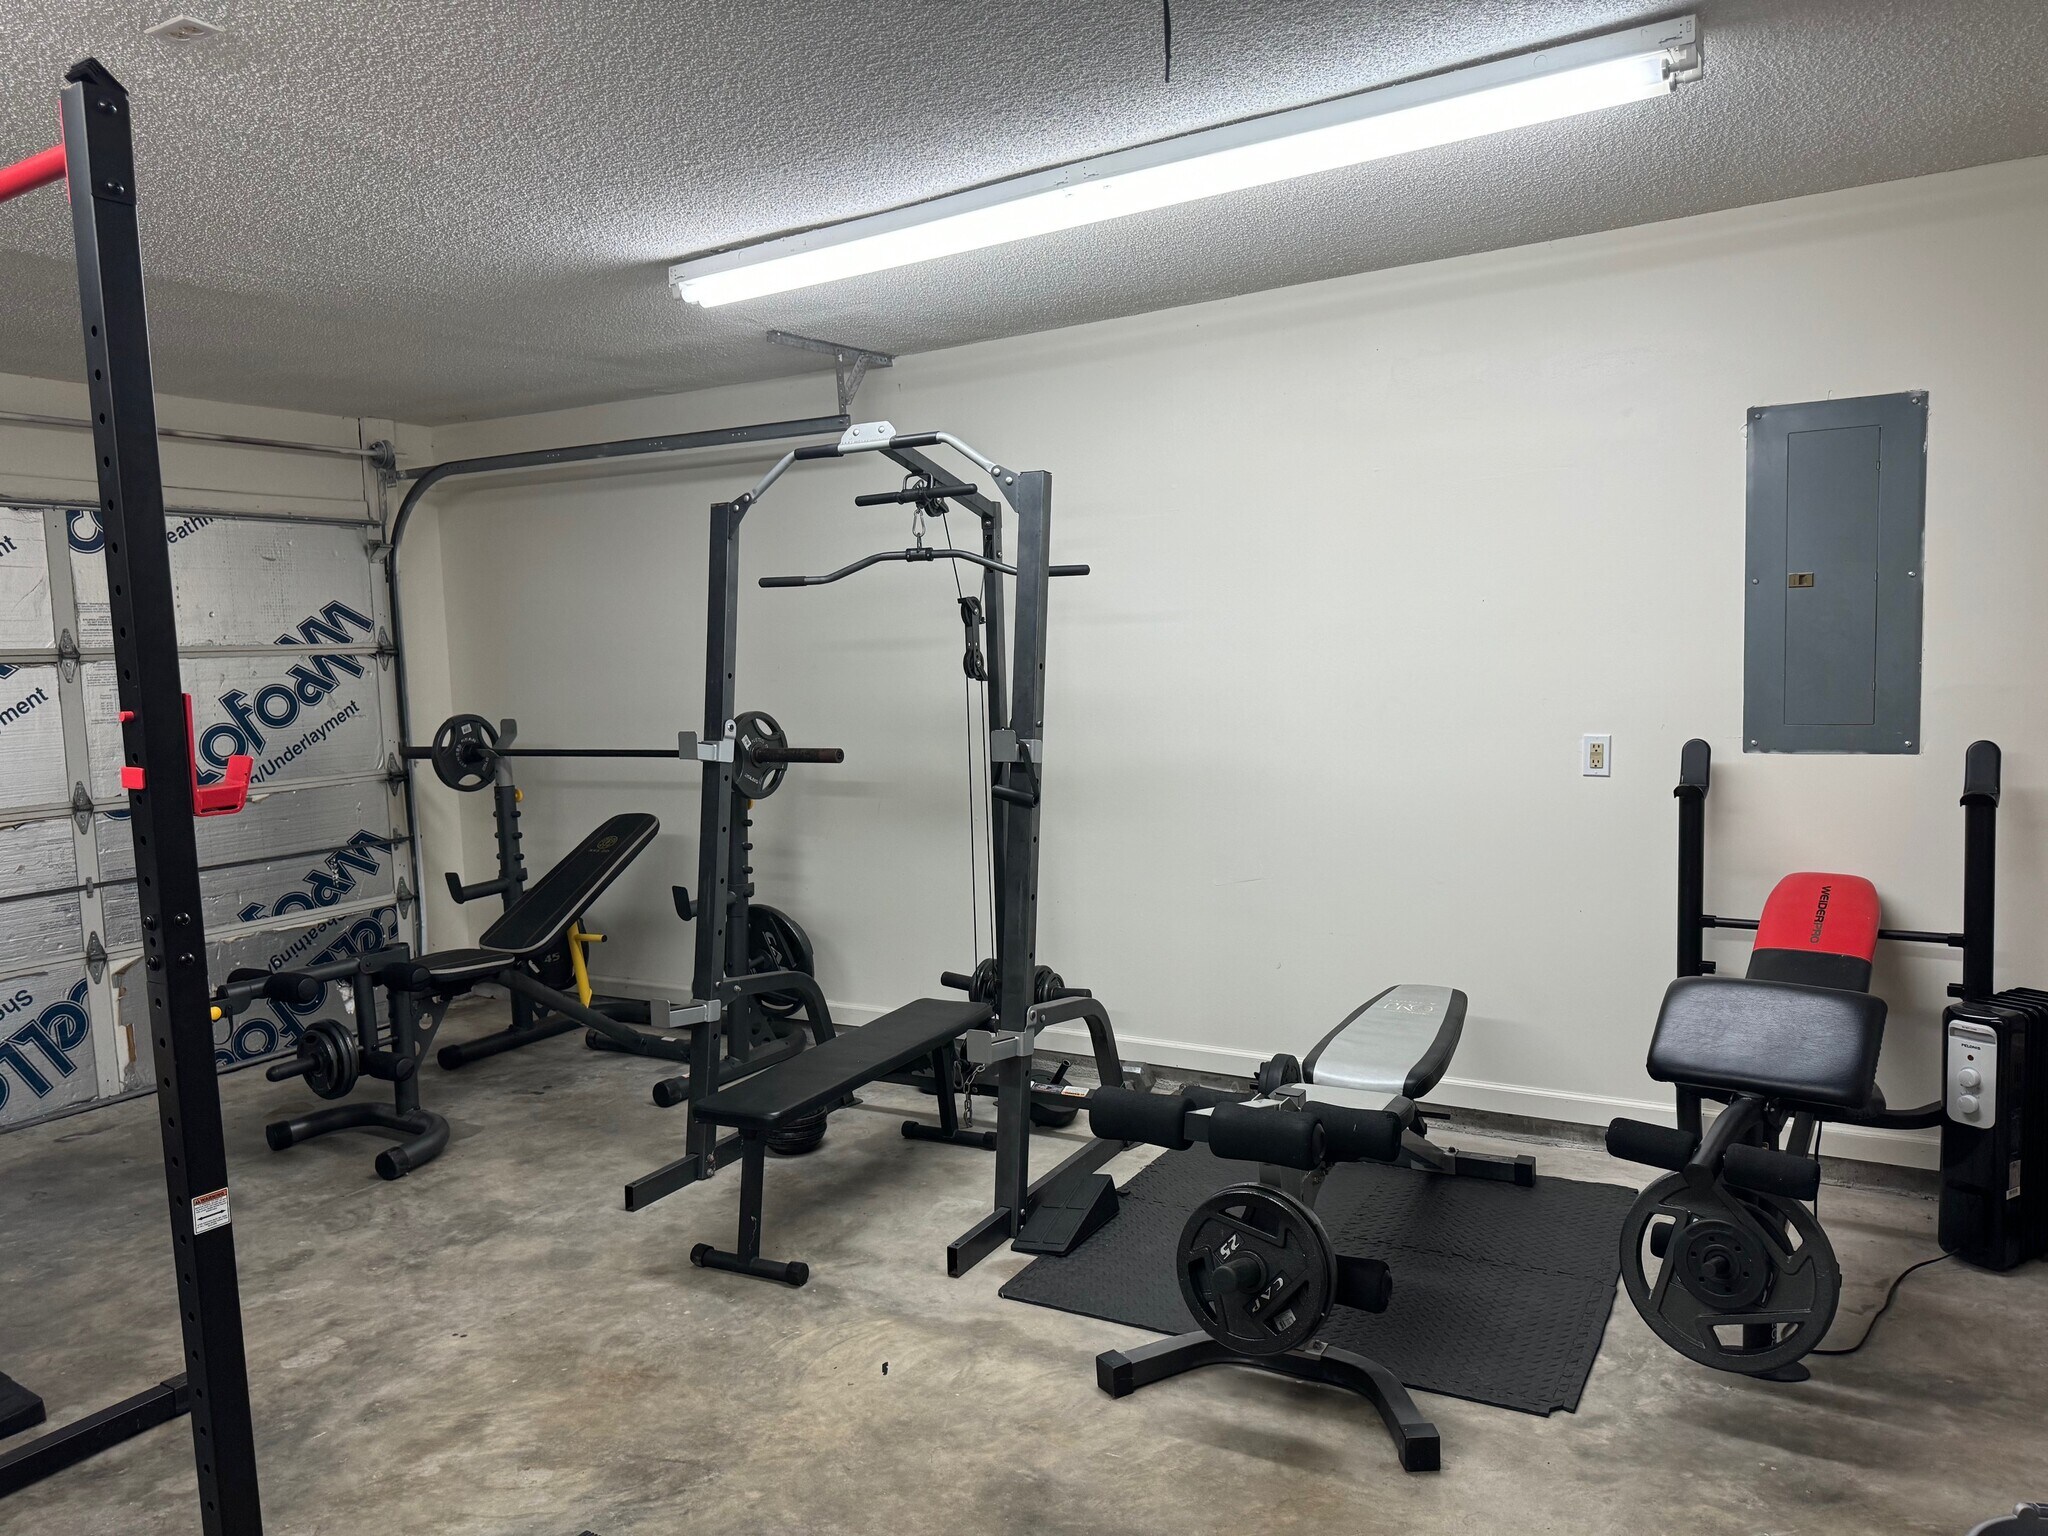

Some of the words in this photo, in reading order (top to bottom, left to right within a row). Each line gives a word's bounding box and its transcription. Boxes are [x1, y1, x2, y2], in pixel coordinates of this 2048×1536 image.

[762, 931, 790, 971] CA
[1219, 1234, 1241, 1260] 25
[1252, 1277, 1284, 1313] CAP
